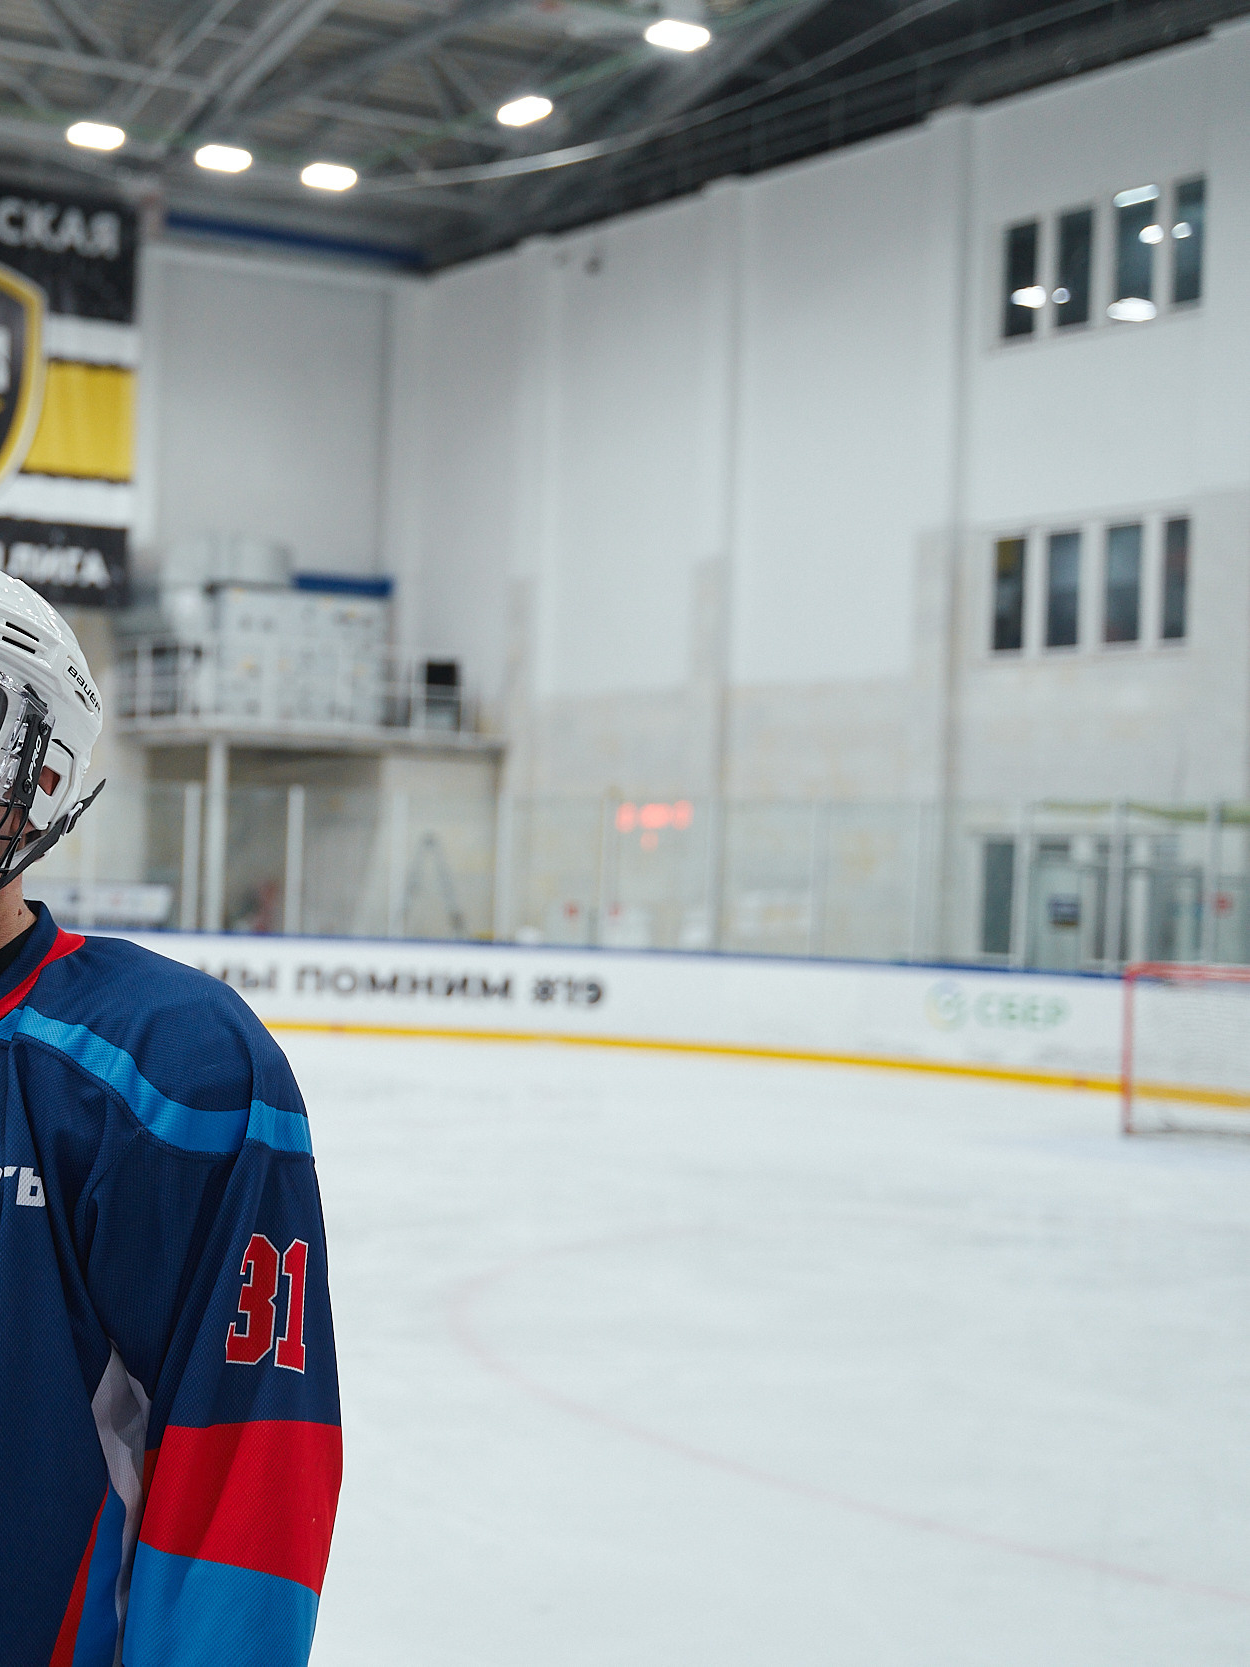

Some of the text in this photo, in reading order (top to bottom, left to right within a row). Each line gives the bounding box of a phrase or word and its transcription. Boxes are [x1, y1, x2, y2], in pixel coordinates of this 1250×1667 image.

[7, 540, 112, 590] ЛИГА
[67, 665, 101, 714] BAUER
[296, 962, 512, 1000] ПОМНИМ
[225, 1233, 309, 1375] 31
